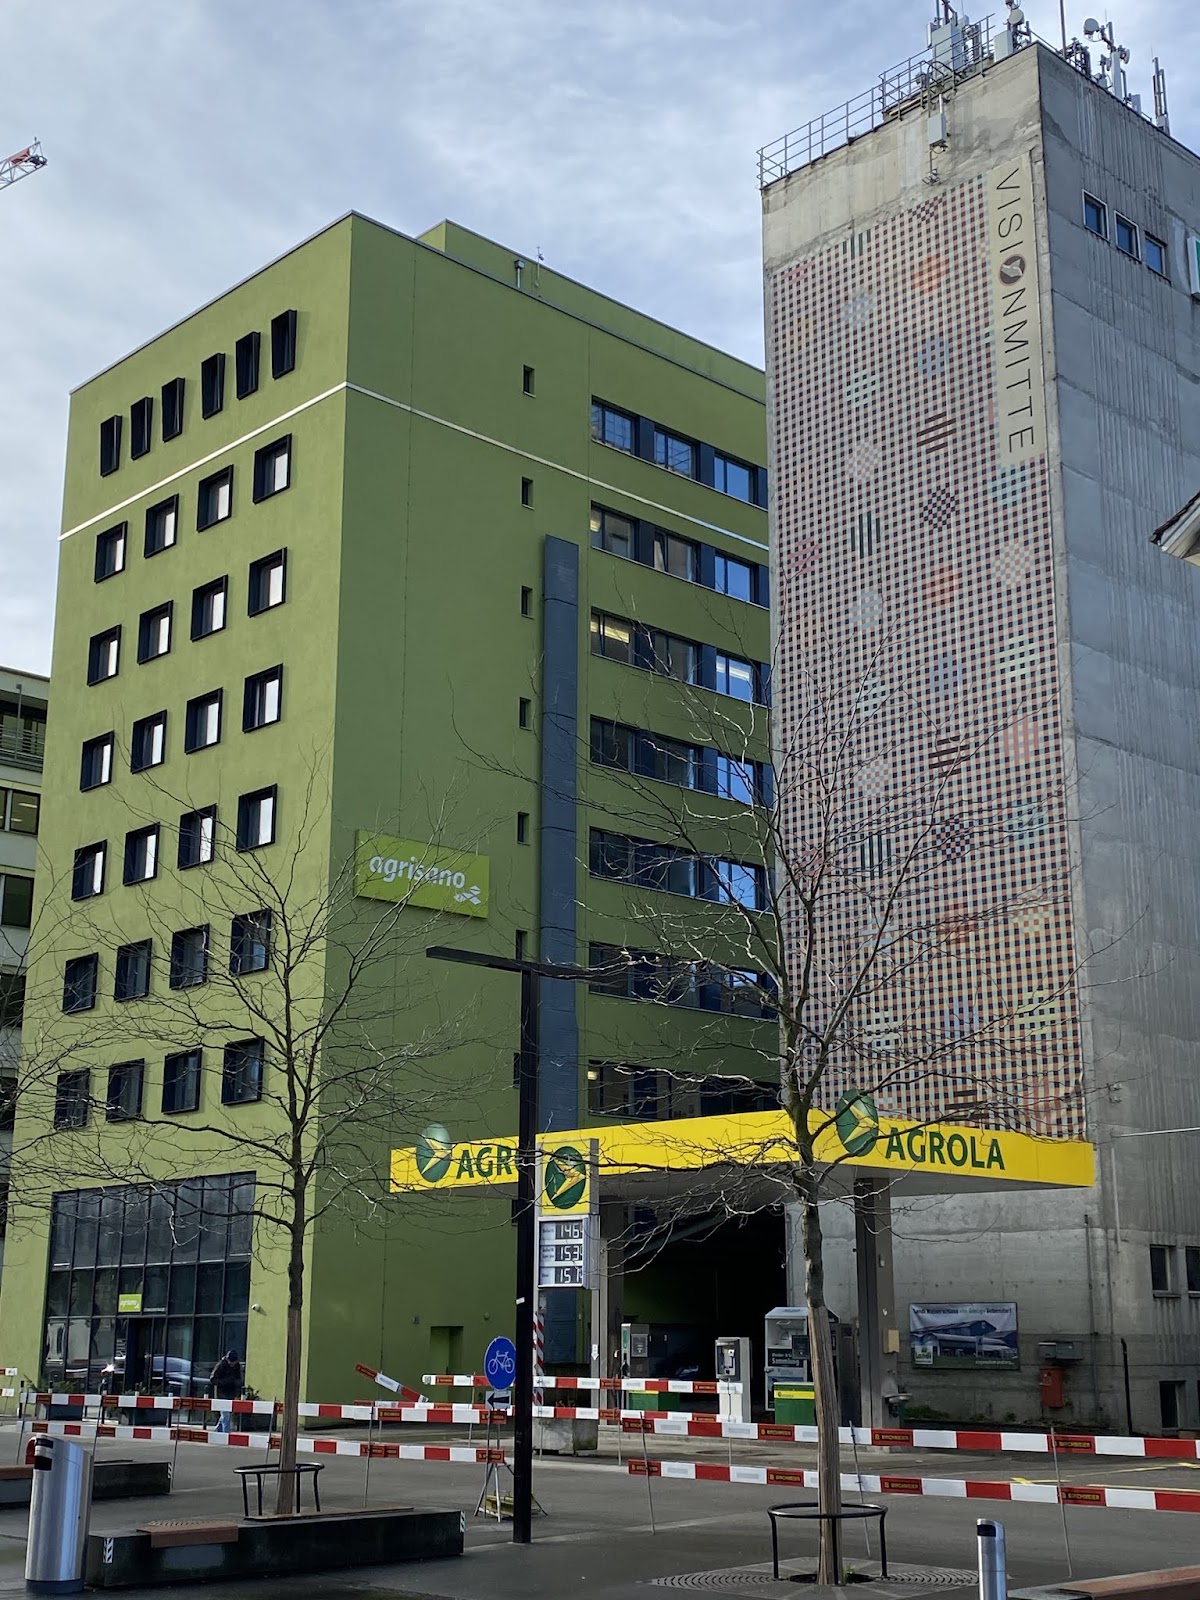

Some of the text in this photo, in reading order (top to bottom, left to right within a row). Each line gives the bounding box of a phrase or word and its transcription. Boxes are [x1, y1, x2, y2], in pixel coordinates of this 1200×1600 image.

[369, 855, 465, 889] agrisano
[456, 1146, 518, 1179] AGR
[885, 1127, 1006, 1170] AGROLA
